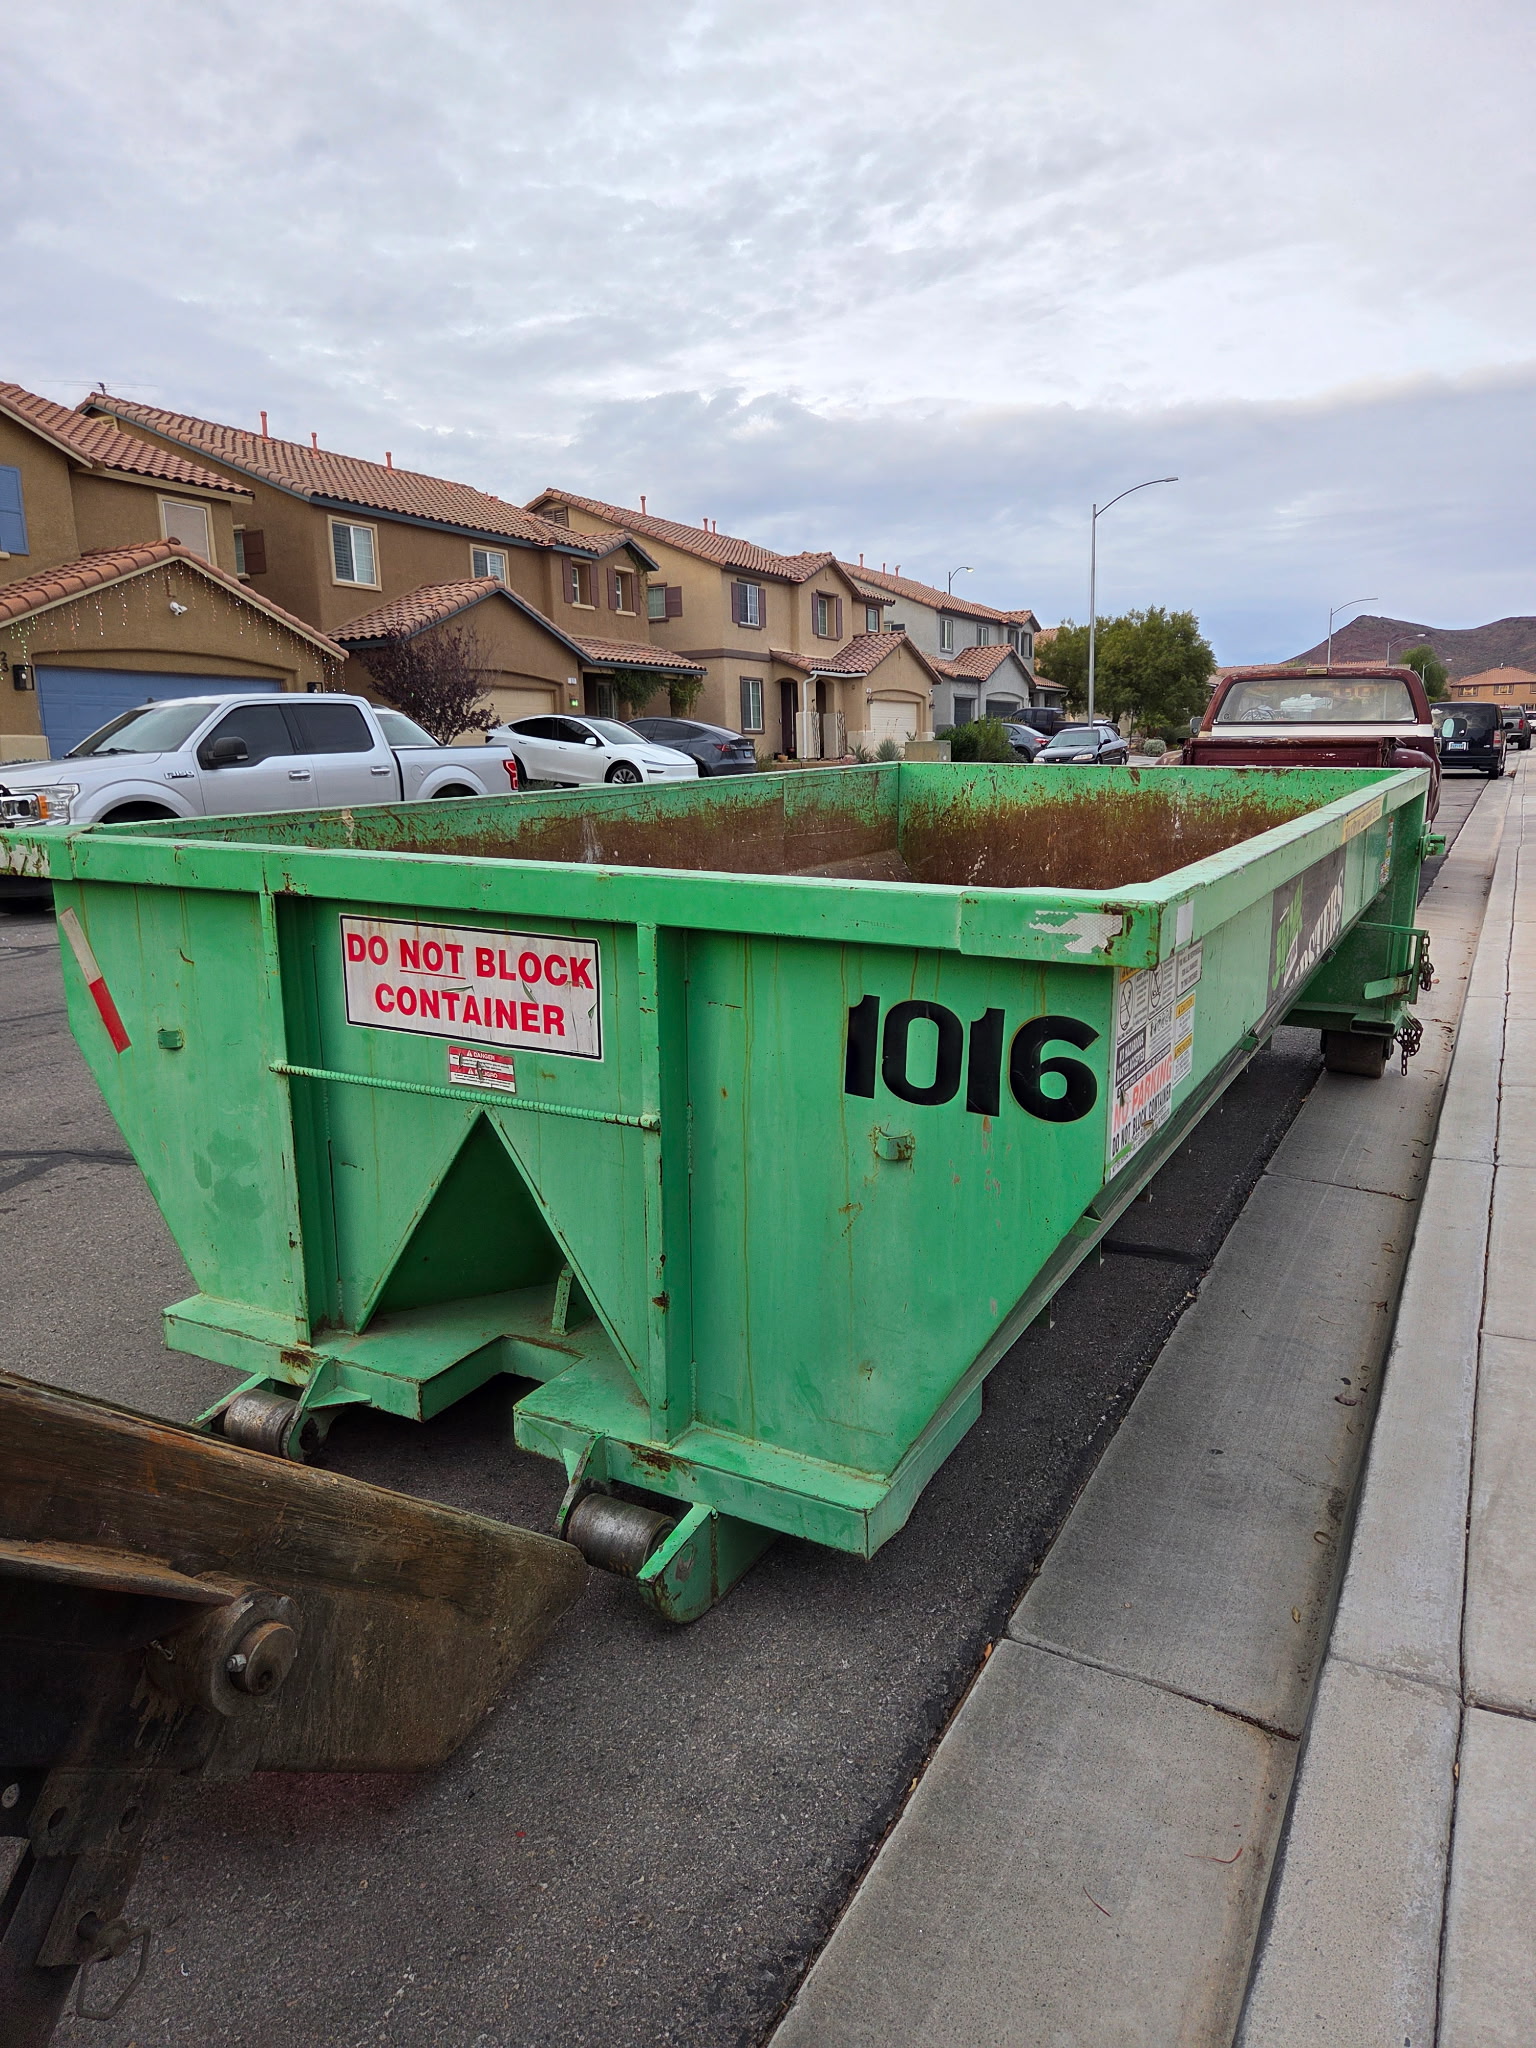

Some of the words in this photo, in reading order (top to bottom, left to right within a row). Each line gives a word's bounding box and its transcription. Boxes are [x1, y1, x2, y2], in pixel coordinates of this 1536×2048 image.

[347, 933, 389, 966] DO
[400, 938, 464, 974] NOT
[476, 946, 594, 990] BLOCK
[375, 983, 565, 1036] CONTAINER
[473, 1051, 496, 1061] DANGER
[845, 994, 1101, 1123] 1016
[1112, 1132, 1119, 1158] DO
[1120, 1122, 1131, 1147] NOT
[1132, 1108, 1147, 1136] BLOCK
[1148, 1082, 1171, 1119] CONTAINER
[1113, 1102, 1129, 1133] NO
[1131, 1054, 1173, 1116] PARKING
